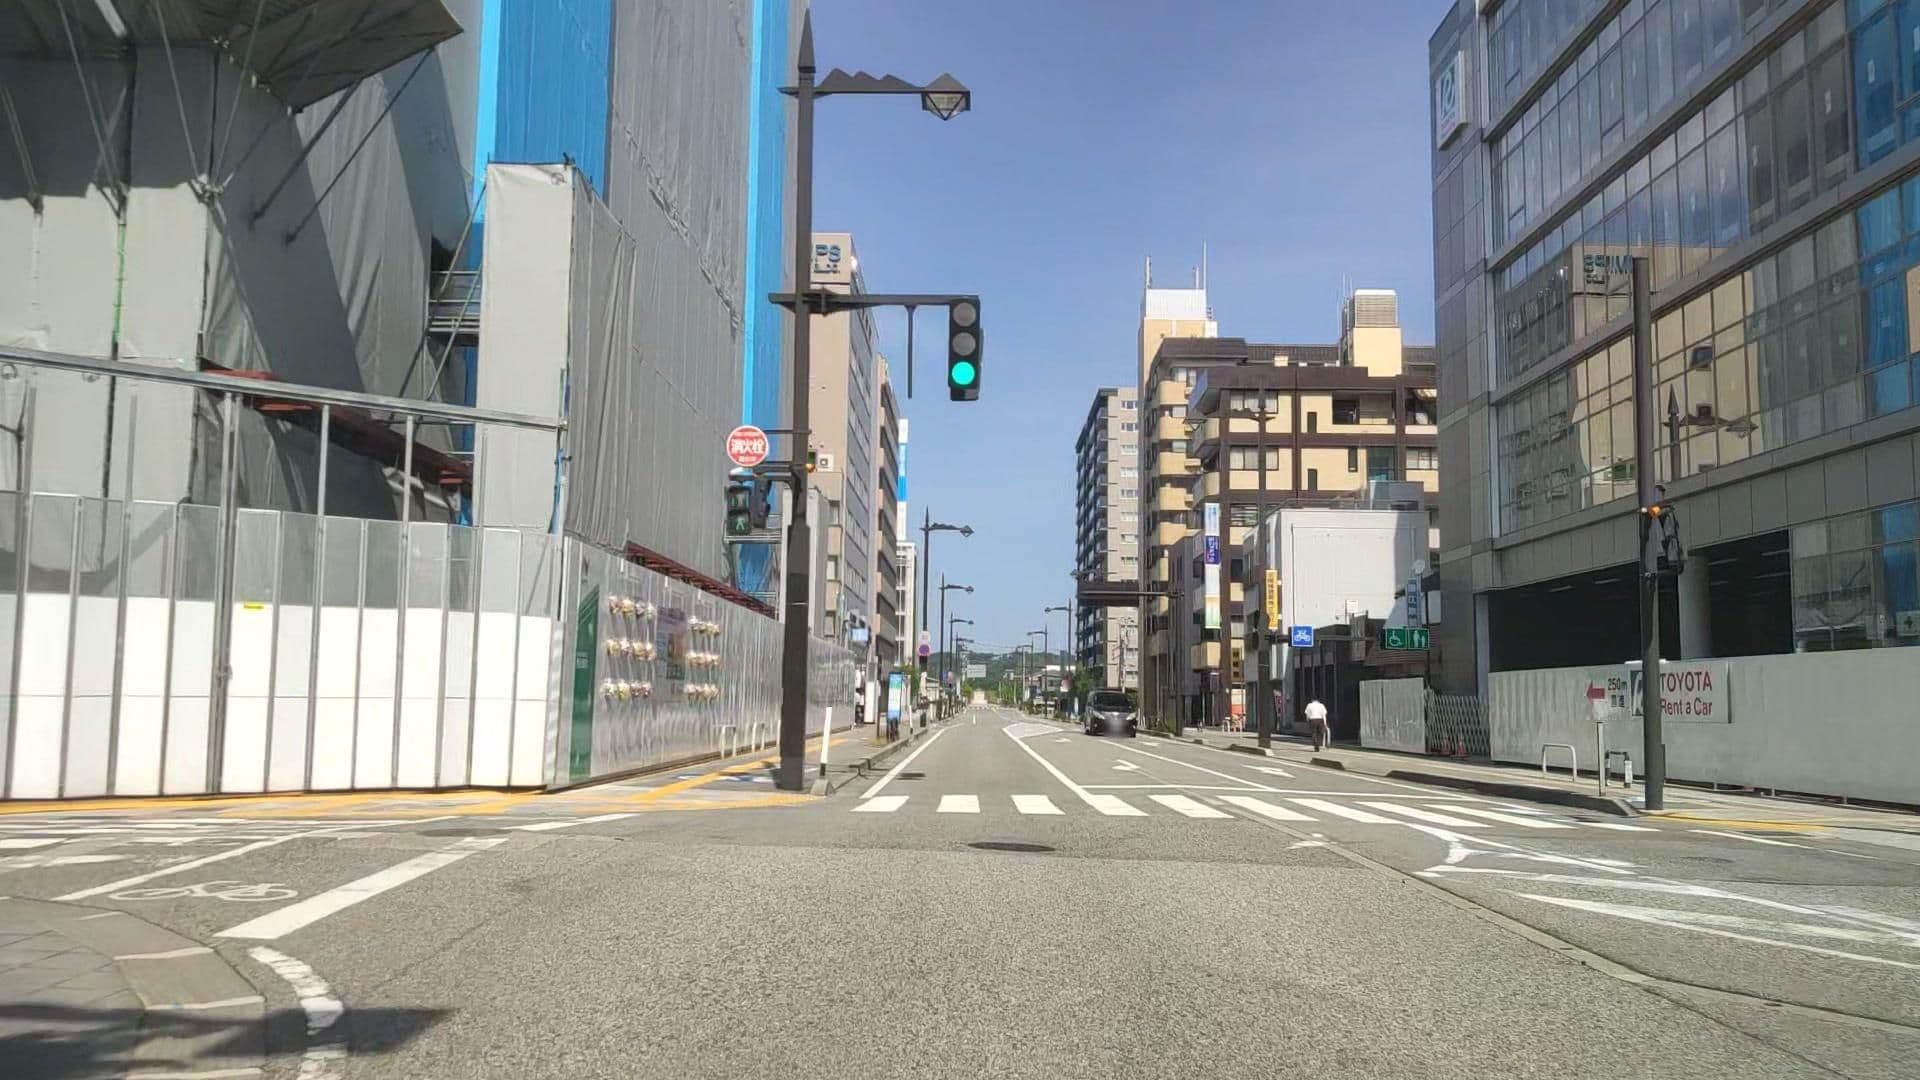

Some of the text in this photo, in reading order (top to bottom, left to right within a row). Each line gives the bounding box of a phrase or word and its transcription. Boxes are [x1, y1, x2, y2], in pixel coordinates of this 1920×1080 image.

[731, 438, 765, 455] 消火栓
[1660, 671, 1713, 692] TOYOTA
[1660, 698, 1713, 716] Rent a Car
